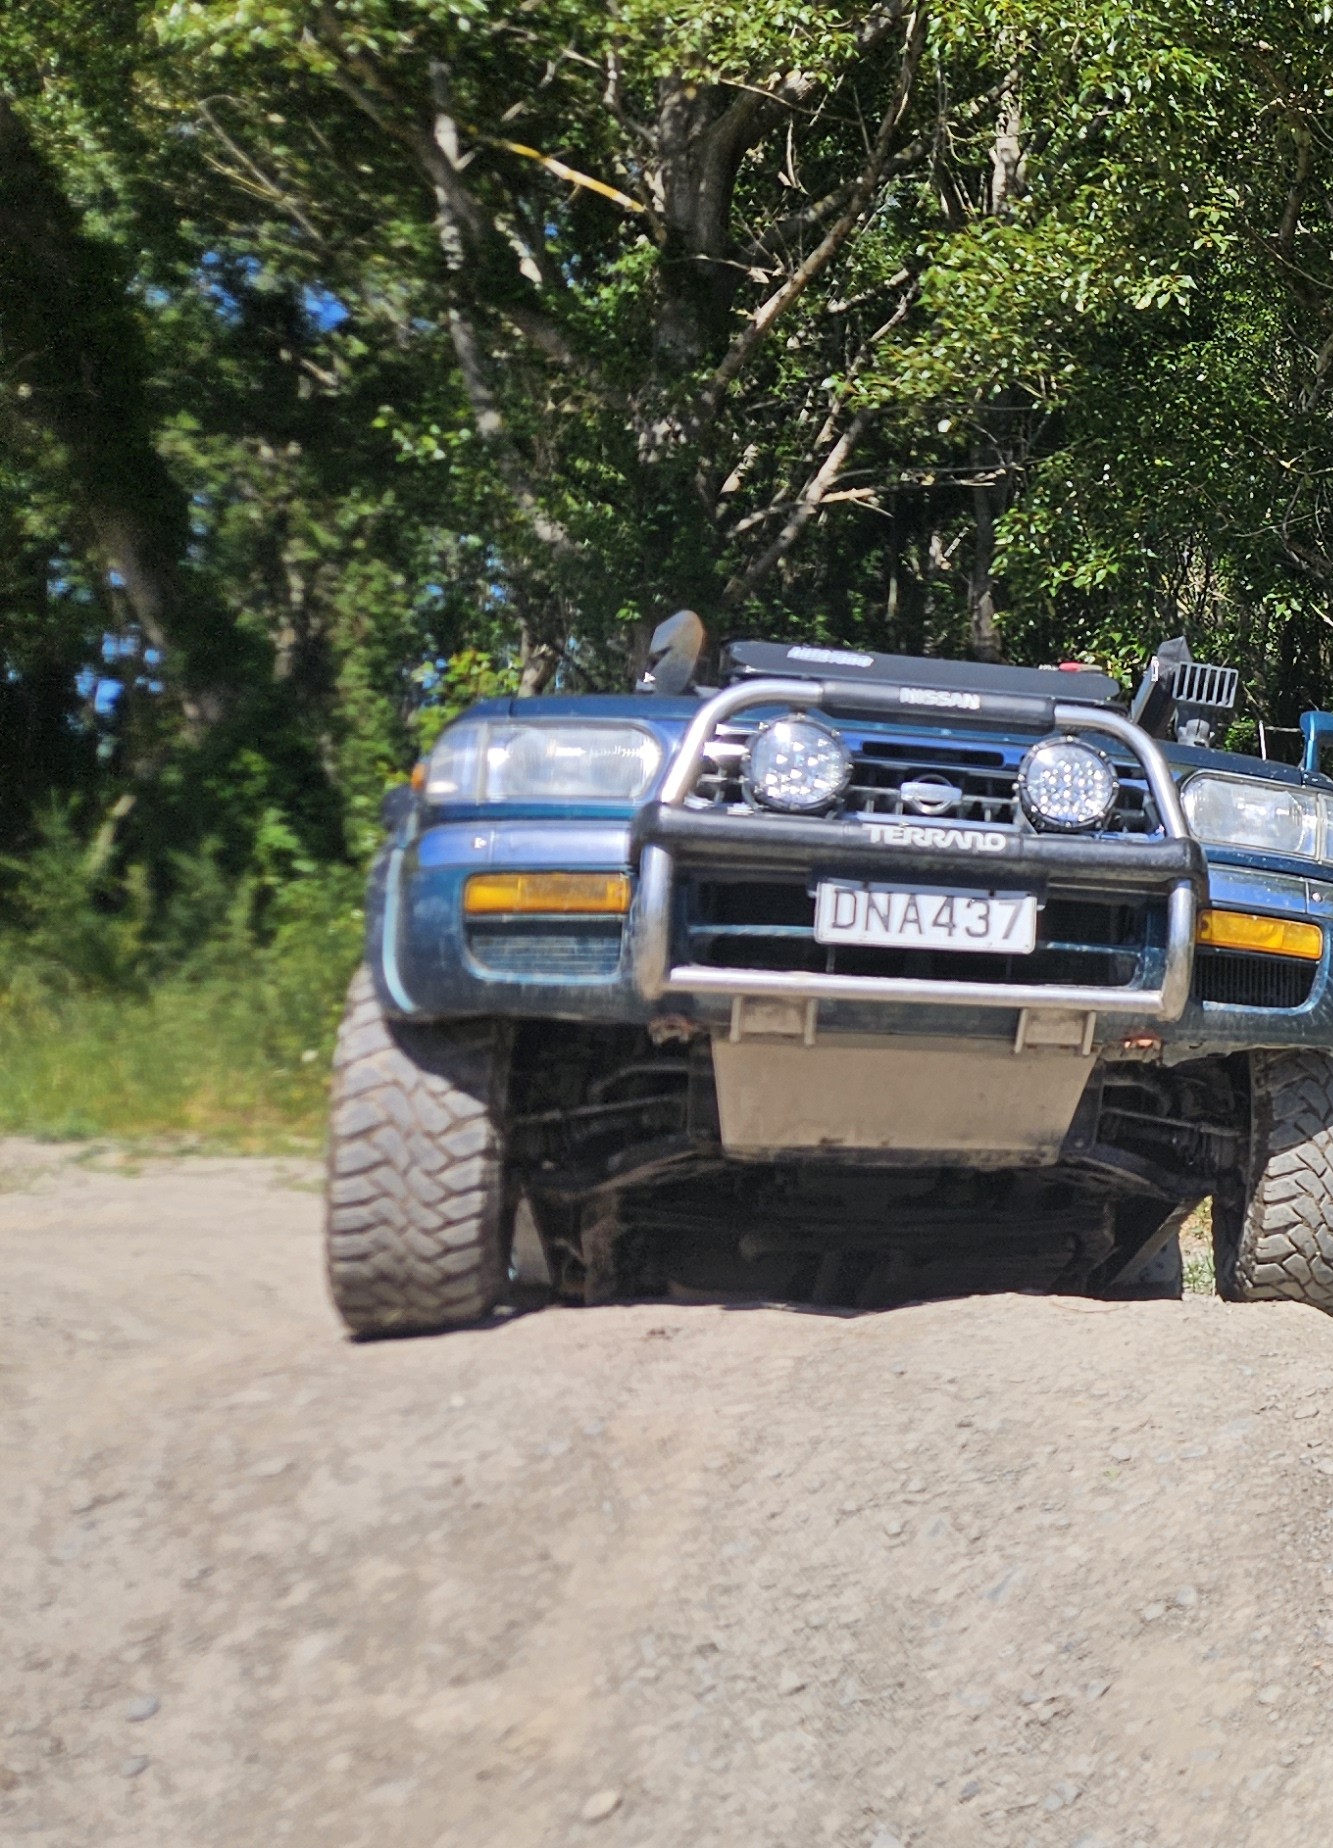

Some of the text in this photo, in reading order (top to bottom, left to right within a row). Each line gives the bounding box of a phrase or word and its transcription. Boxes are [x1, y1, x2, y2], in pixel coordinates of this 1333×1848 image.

[899, 687, 981, 710] NISSAN
[862, 823, 1006, 851] TERRANO
[831, 888, 1025, 940] DNA437
